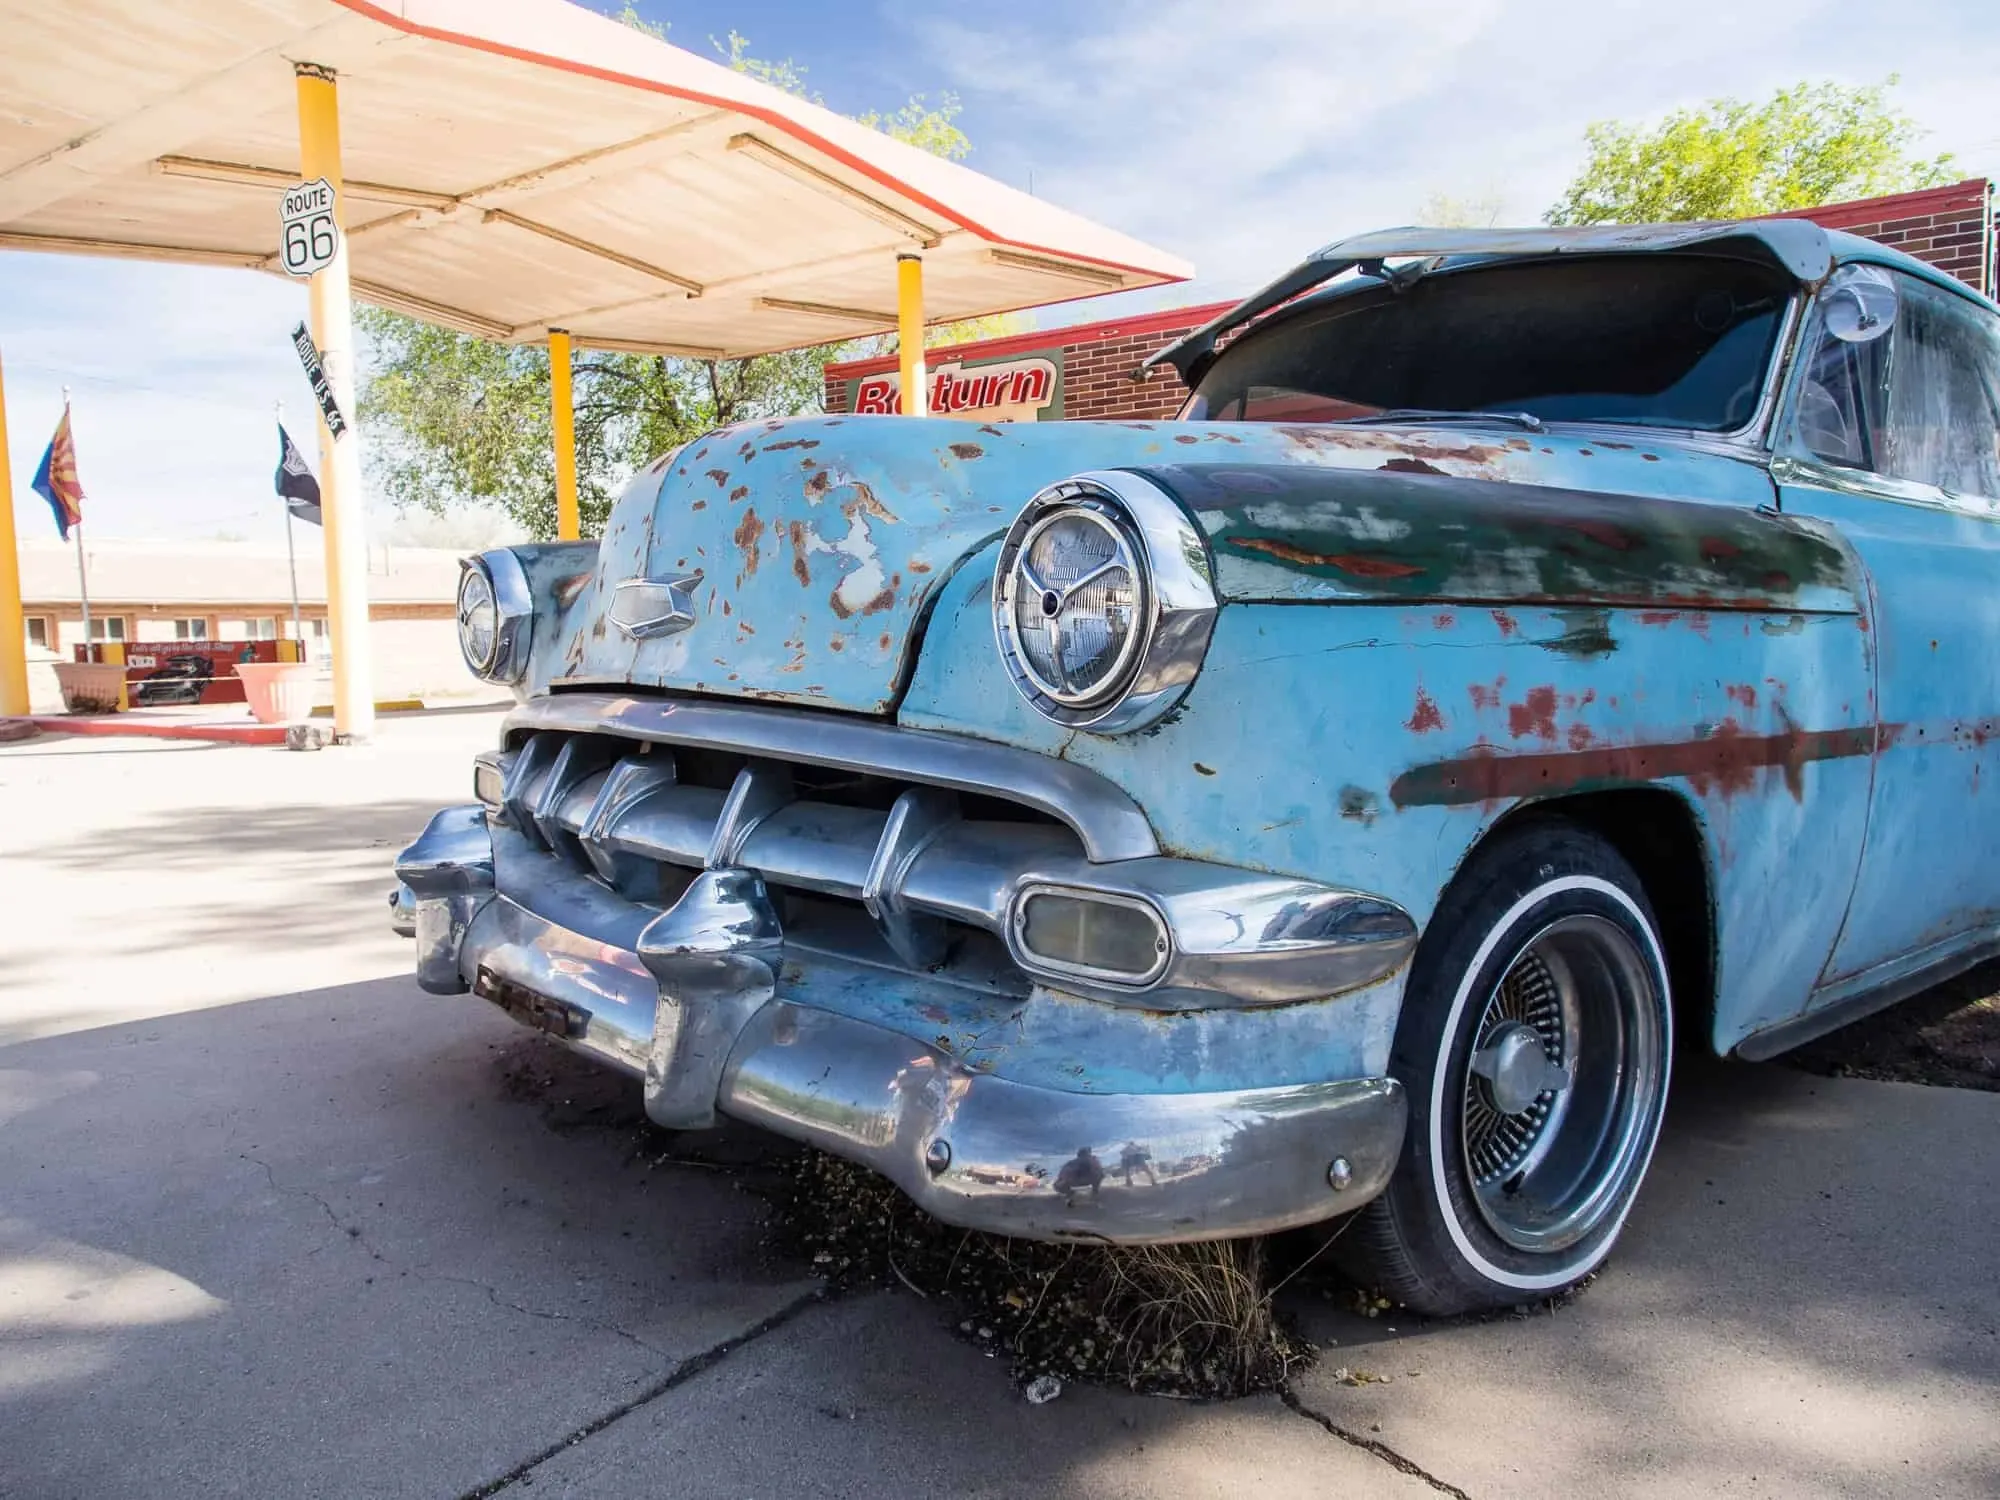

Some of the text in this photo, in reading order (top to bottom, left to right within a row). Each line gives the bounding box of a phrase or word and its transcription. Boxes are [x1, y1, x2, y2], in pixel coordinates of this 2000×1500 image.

[286, 188, 327, 215] ROUTE
[286, 215, 333, 267] 66
[296, 334, 319, 379] ROUTE
[327, 410, 341, 430] 66
[855, 367, 1047, 414] Rturn
